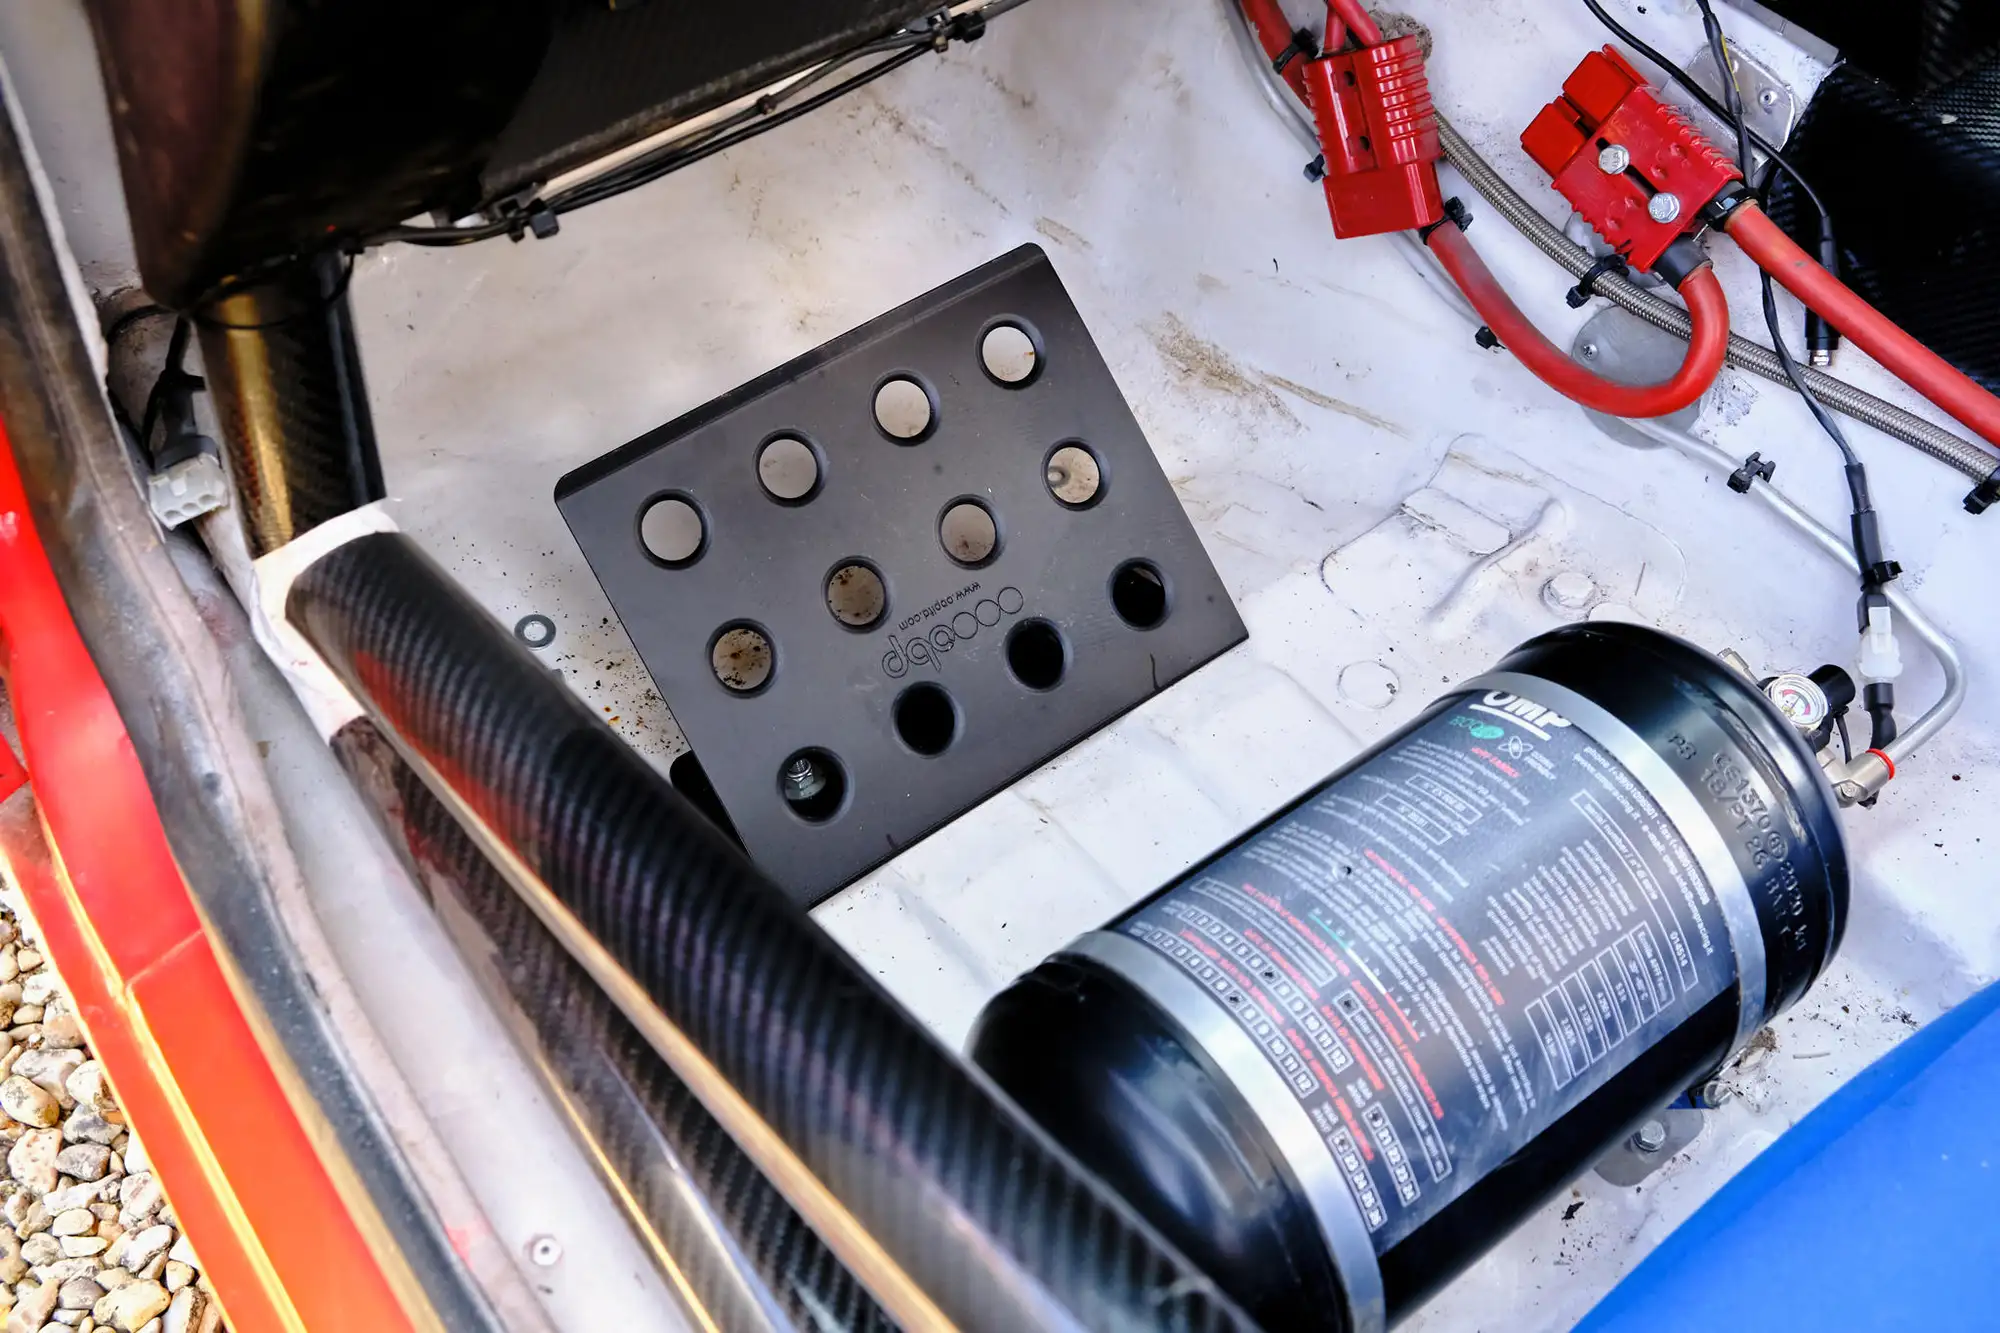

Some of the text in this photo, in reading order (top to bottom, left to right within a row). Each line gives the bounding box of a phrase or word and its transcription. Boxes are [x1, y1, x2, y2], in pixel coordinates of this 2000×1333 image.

[1483, 692, 1571, 728] OMP
[1582, 745, 1611, 769] phone
[1657, 822, 1674, 841] fax
[1583, 802, 1607, 825] serial
[1601, 823, 1630, 855] number
[1776, 860, 1807, 917] 2020
[1448, 948, 1462, 963] be
[1352, 1013, 1372, 1036] other
[1386, 986, 1428, 1039] ITALY
[1269, 1038, 1286, 1056] 10
[1282, 1056, 1298, 1072] 11
[1293, 1072, 1312, 1092] 12
[1304, 1014, 1320, 1031] 10
[1317, 1032, 1333, 1048] 11
[1329, 1048, 1347, 1067] 12
[1366, 1108, 1385, 1128] 0
